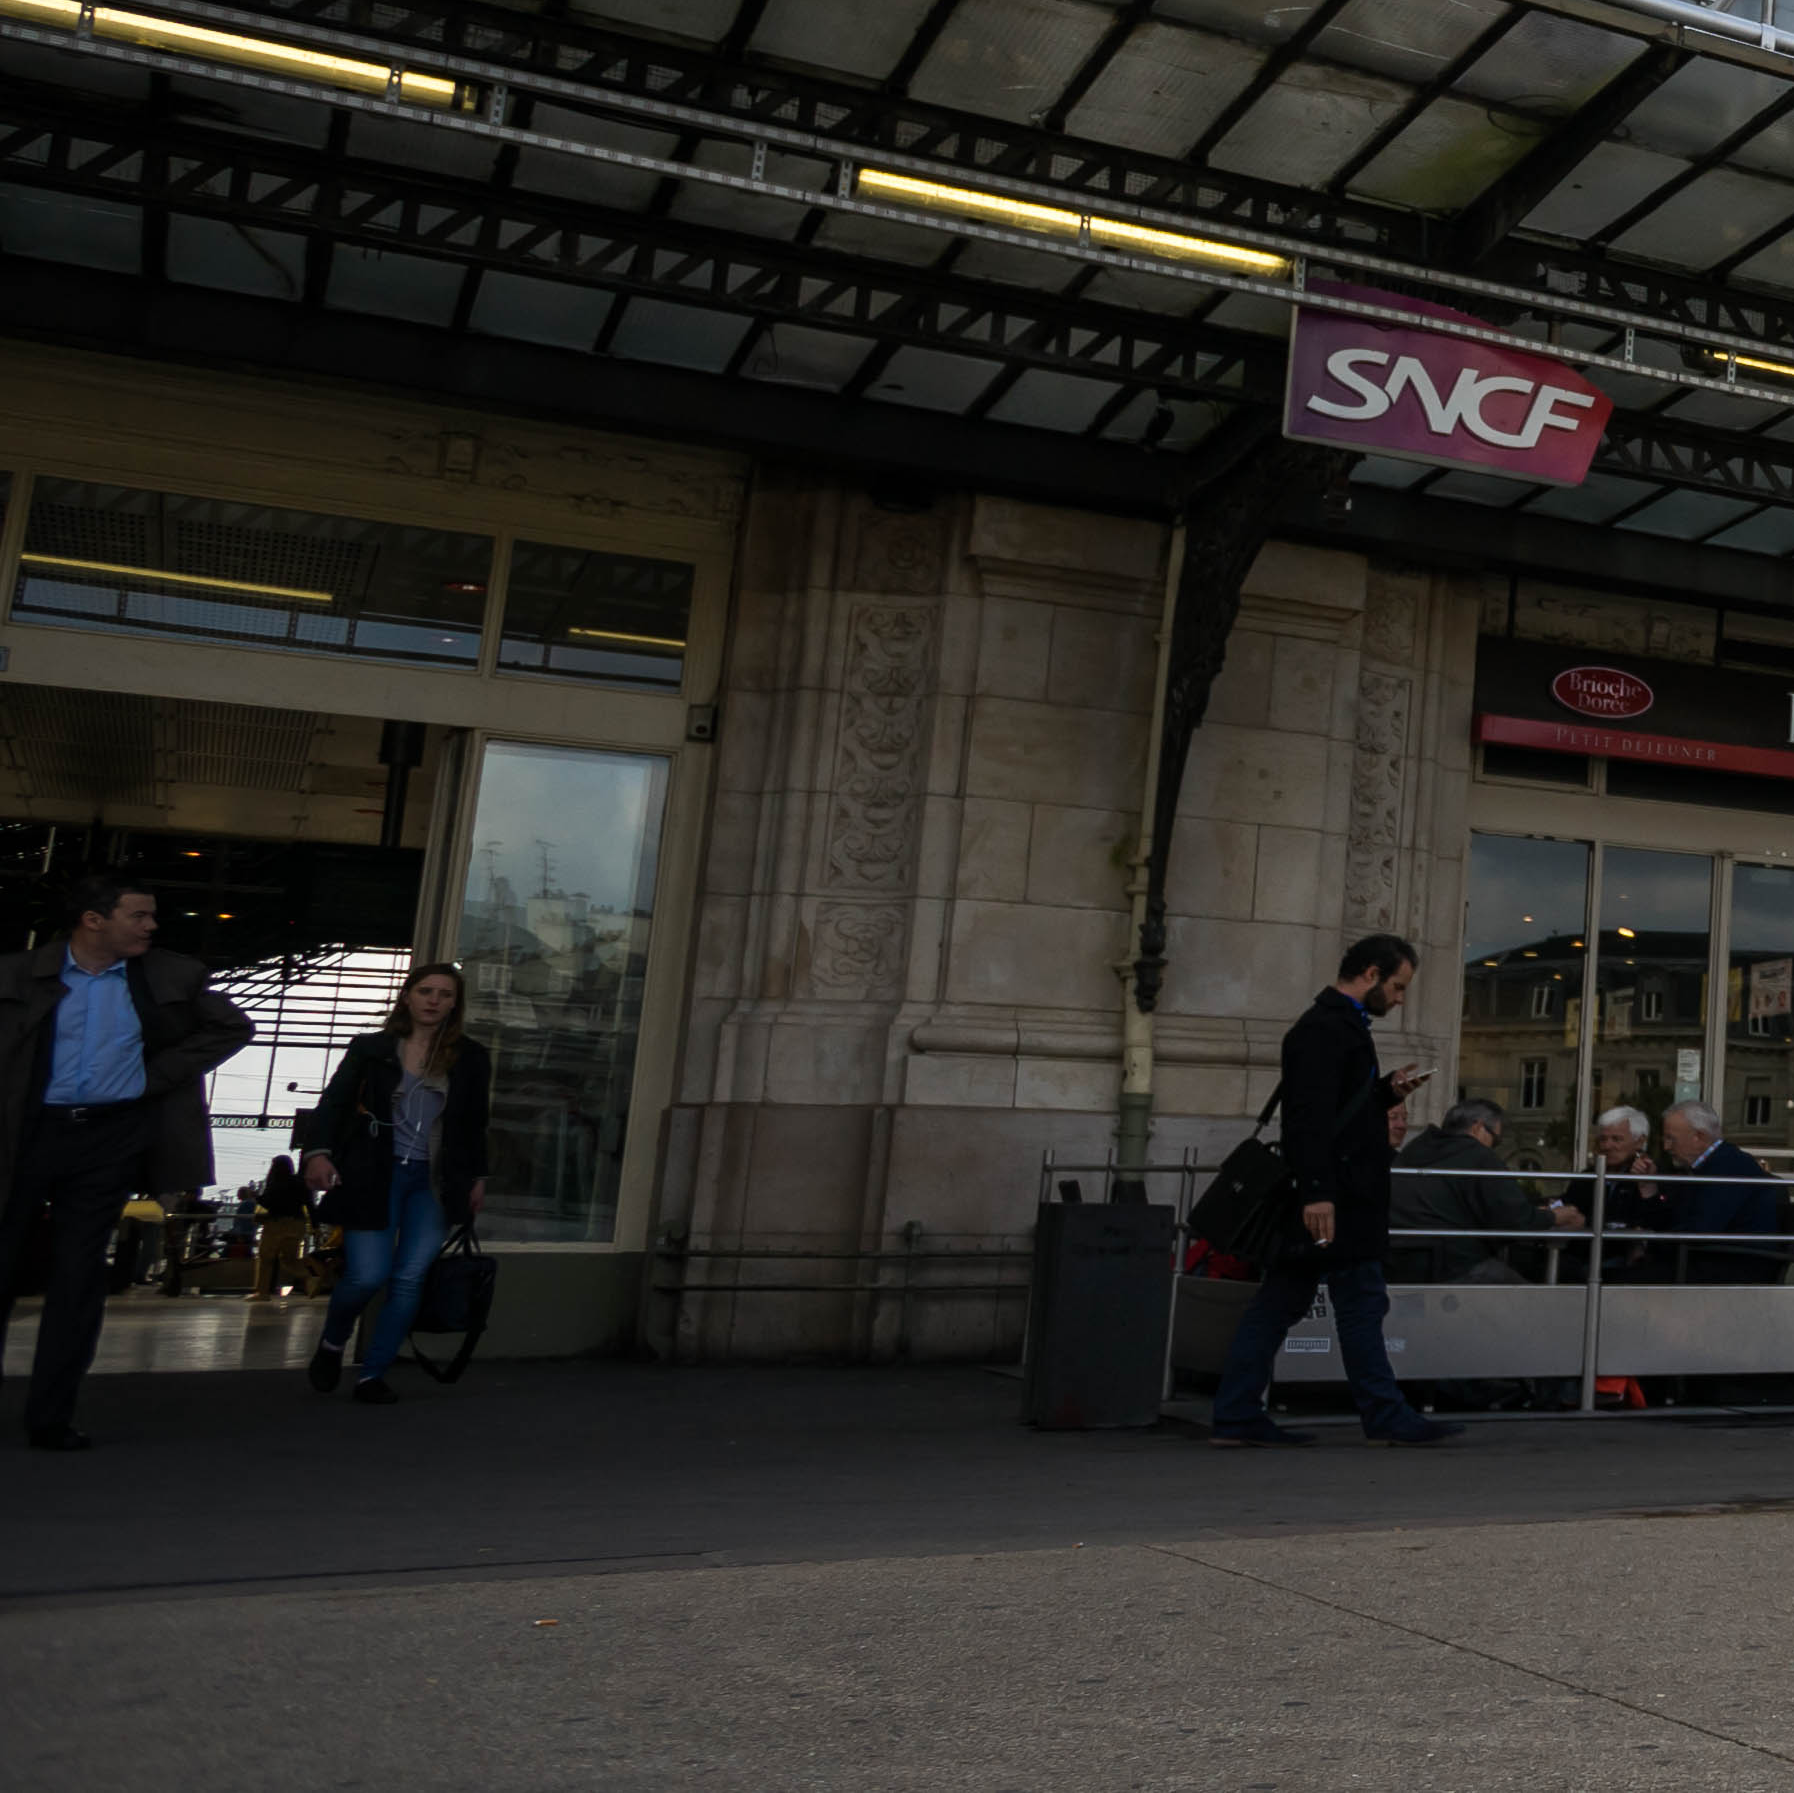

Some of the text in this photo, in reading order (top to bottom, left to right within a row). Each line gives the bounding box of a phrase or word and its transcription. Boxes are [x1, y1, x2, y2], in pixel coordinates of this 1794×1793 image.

[1306, 346, 1596, 449] SNCF
[1569, 671, 1642, 699] Brioche
[1555, 725, 1616, 750] PETIT
